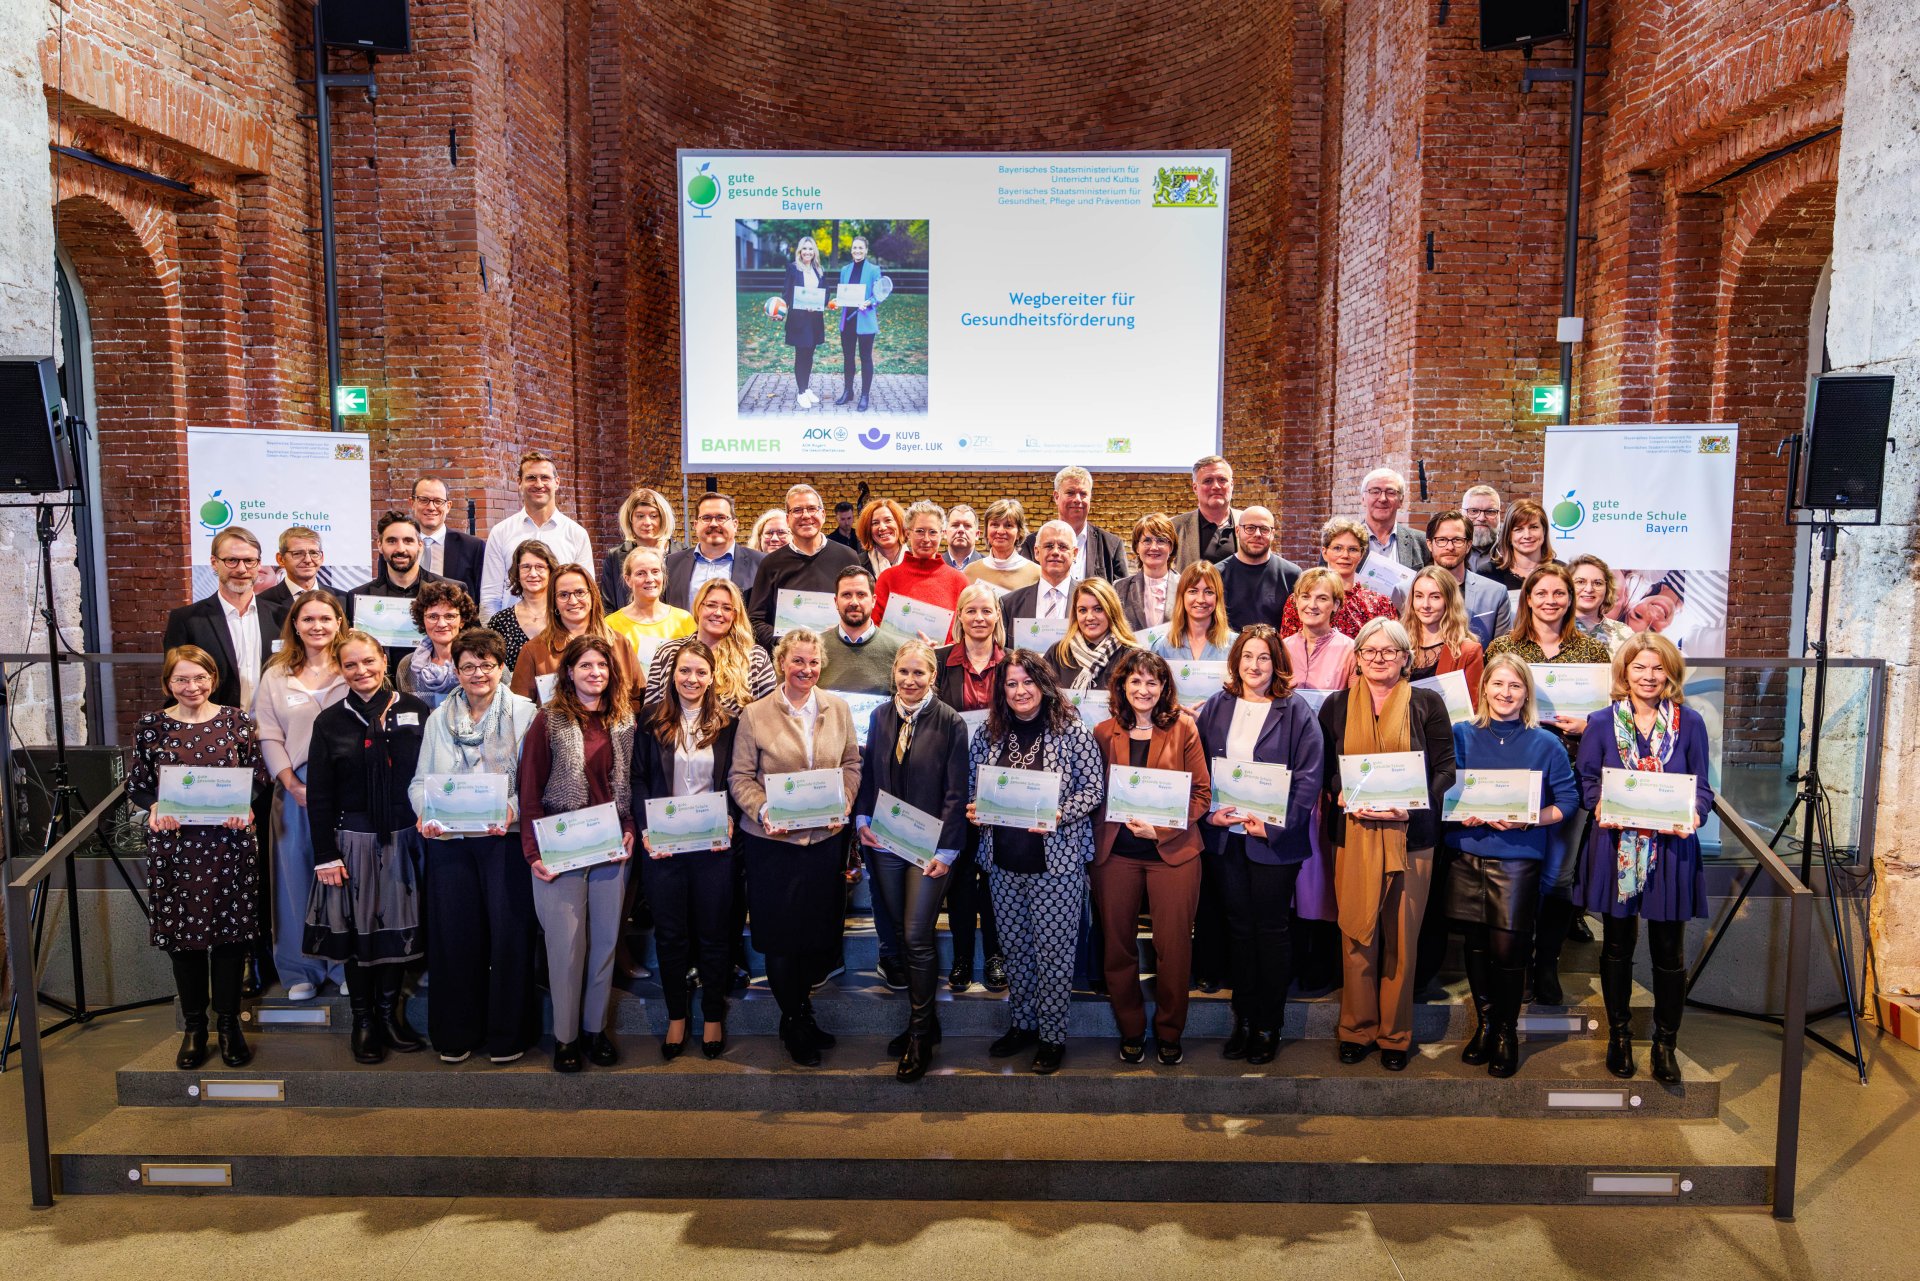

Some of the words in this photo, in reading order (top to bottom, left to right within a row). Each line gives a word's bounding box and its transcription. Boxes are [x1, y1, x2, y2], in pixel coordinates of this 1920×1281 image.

[998, 165, 1048, 174] Bayerisches
[1049, 165, 1125, 173] Staatsministerium
[1127, 165, 1140, 173] für
[728, 173, 755, 185] gute
[1051, 175, 1092, 183] Unterricht
[1094, 175, 1111, 183] und
[1113, 175, 1140, 183] Kultus
[728, 186, 778, 199] gesunde
[782, 186, 821, 197] Schule
[998, 187, 1048, 196] Bayerisches
[1050, 187, 1127, 195] Staatsministerium
[1129, 187, 1142, 195] für
[782, 200, 823, 212] Bayern
[998, 197, 1048, 206] Gesundheit,
[1050, 197, 1076, 206] Pflege
[1078, 197, 1094, 205] und
[1096, 197, 1141, 205] Prävention
[1009, 292, 1107, 309] Wegbereiter
[1111, 292, 1136, 306] für
[961, 312, 1136, 330] Gesundheitsförderung
[802, 428, 832, 440] AOK
[896, 431, 920, 440] KUVB
[701, 438, 781, 452] BARMER
[896, 442, 923, 453] Bayer.
[925, 442, 943, 451] LUK
[240, 500, 266, 510] gute
[1592, 500, 1620, 511] gute
[240, 511, 289, 521] gesunde
[292, 511, 329, 521] Schule
[1592, 511, 1643, 522] gesunde
[1647, 511, 1687, 521] Schule
[1646, 523, 1689, 535] Bayern
